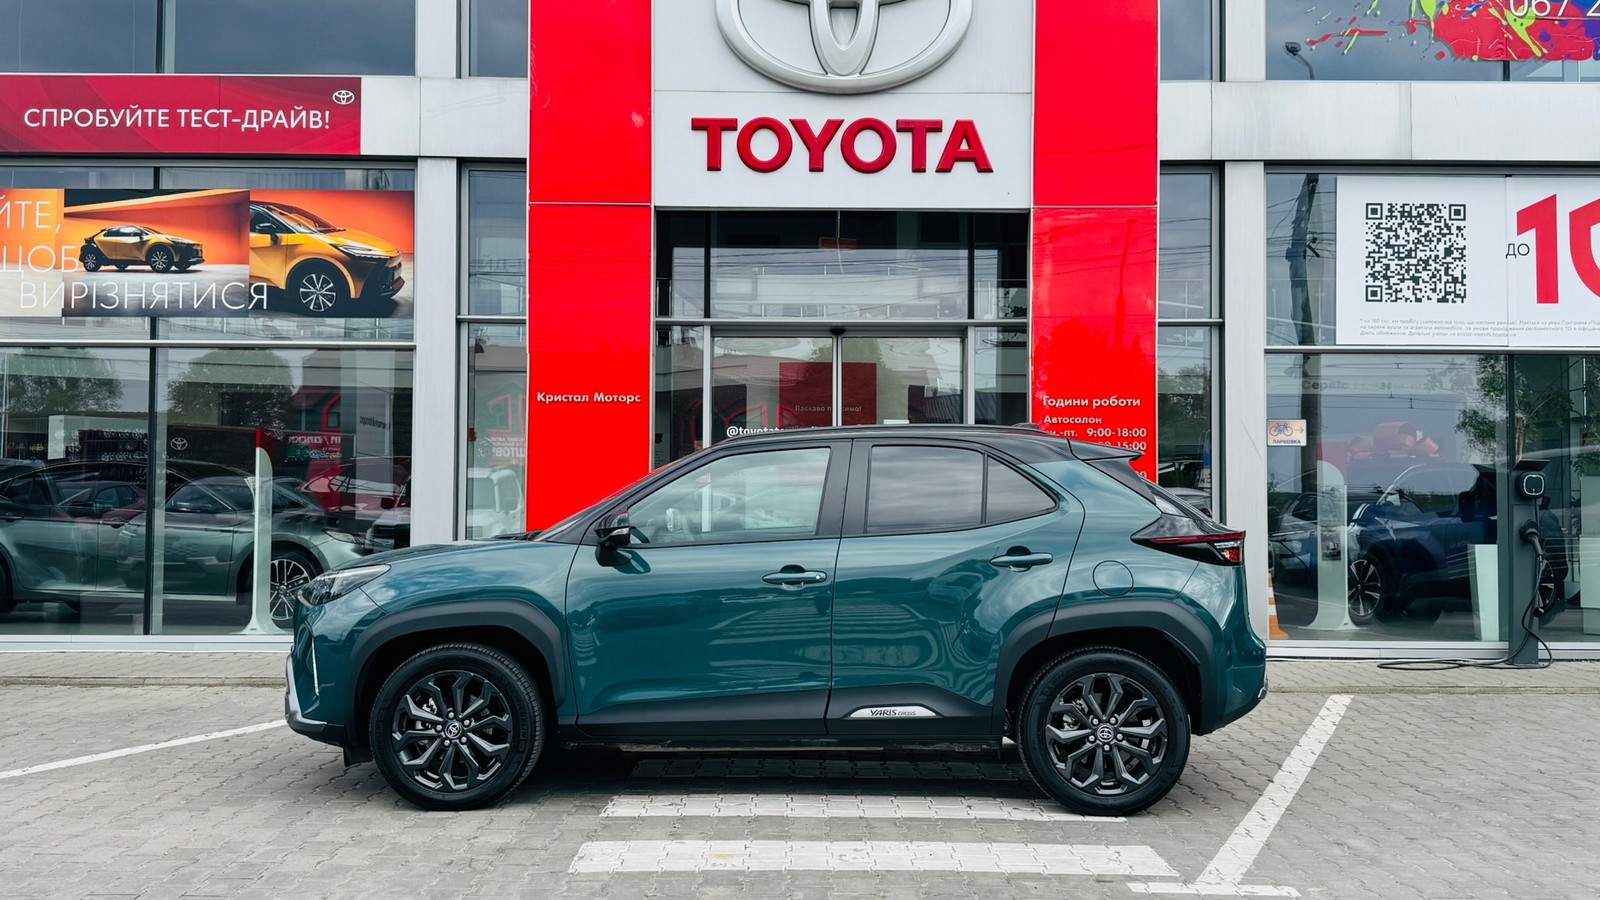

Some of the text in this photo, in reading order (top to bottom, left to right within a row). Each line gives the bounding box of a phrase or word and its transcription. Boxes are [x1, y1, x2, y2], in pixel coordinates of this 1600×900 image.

[24, 105, 331, 132] СПРОБУЙТЕ ТЕСТ-ДРАЙВ!
[691, 116, 994, 174] TOYOTA
[20, 282, 268, 310] ВИРІЗНЯТИСЯ
[537, 392, 641, 404] Кристал Моторс
[1043, 395, 1141, 409] Години роботи
[1043, 415, 1102, 424] Автосалон
[1086, 428, 1147, 437] 9:00-18:00
